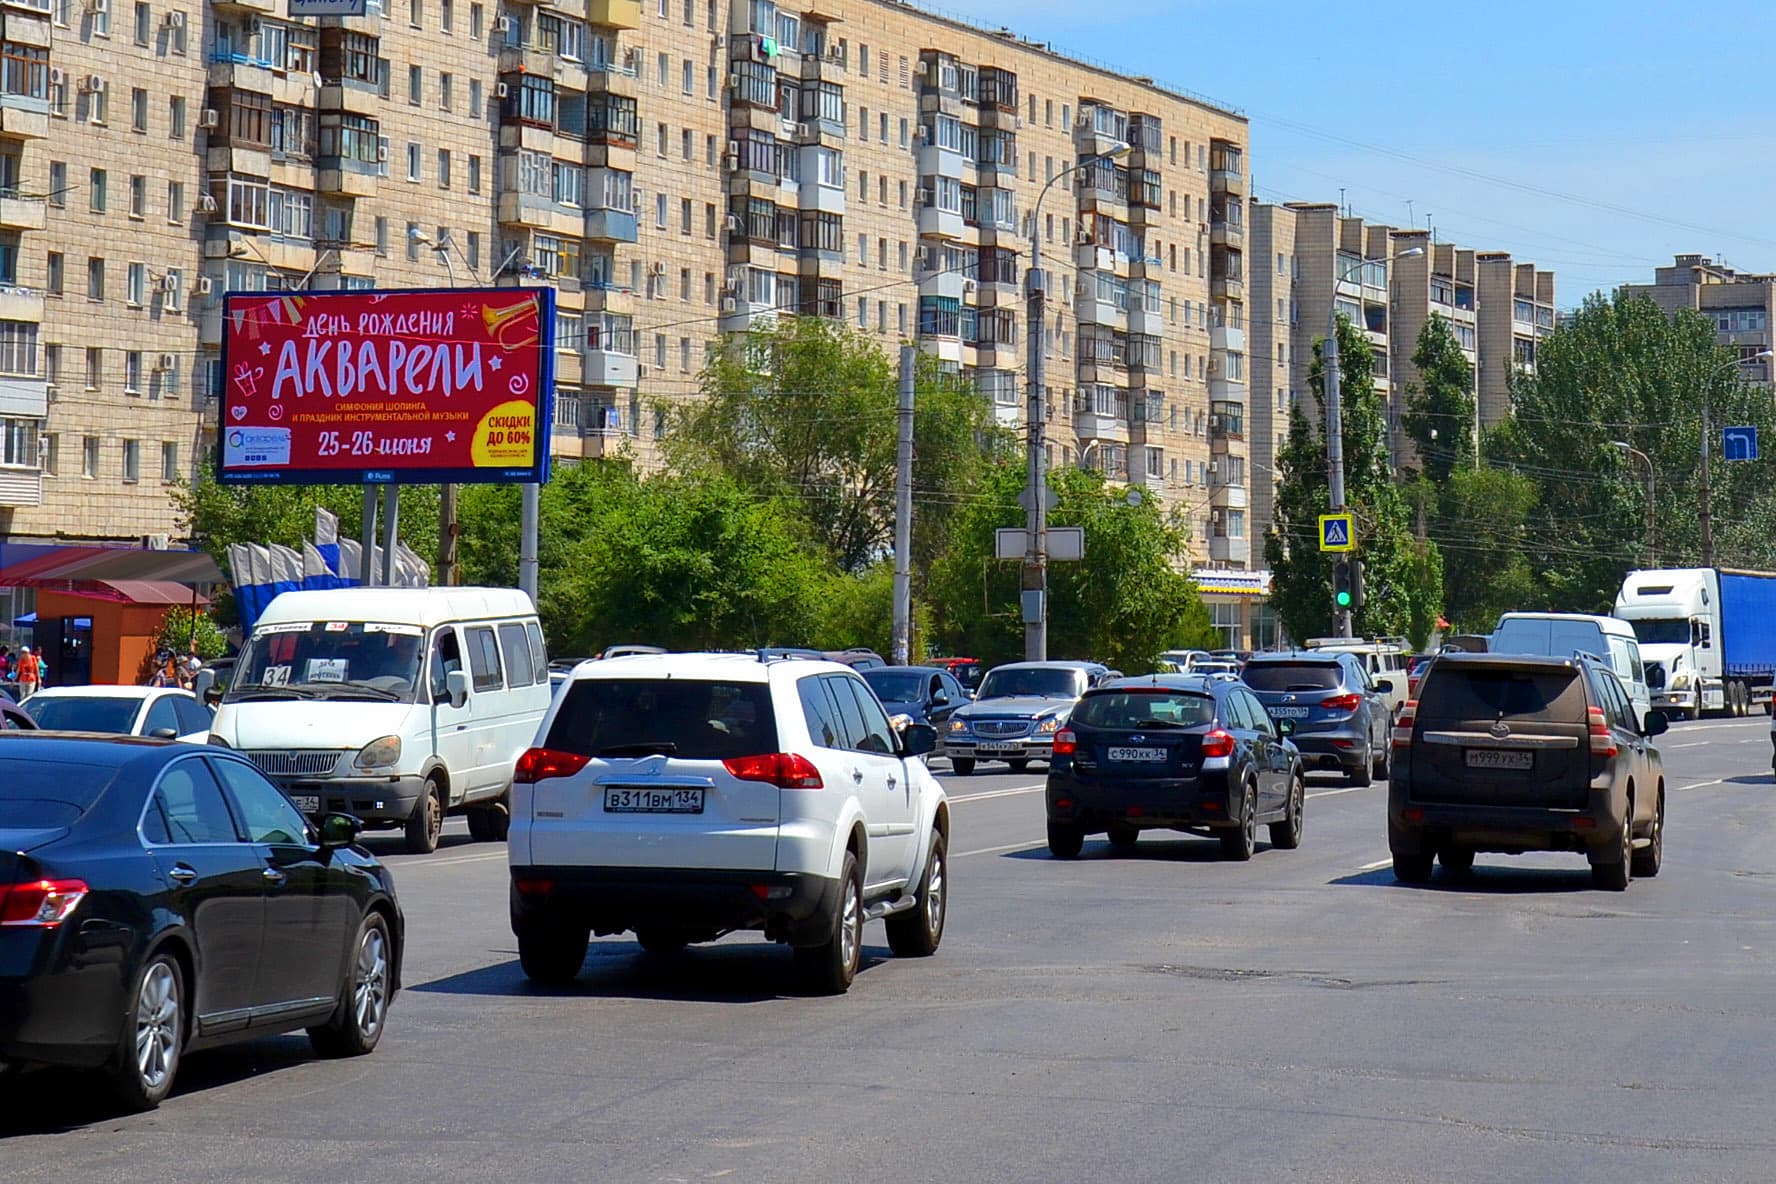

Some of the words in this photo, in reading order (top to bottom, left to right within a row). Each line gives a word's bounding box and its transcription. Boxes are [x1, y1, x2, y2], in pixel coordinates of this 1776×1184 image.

[335, 402, 384, 412] СИМФОНИЯ
[385, 401, 427, 411] ШОПИНГА
[292, 413, 299, 423] И
[300, 412, 343, 423] ПРАЗДНИК
[344, 410, 431, 422] ИНСТРУМЕНТАЛЬНОЙ
[432, 411, 469, 421] МУЗЫКИ
[488, 415, 531, 430] СКИДКИ
[486, 431, 504, 447] ДО
[507, 430, 531, 445] 60%
[264, 667, 292, 687] 34
[610, 790, 672, 807] В311ВМ
[675, 790, 699, 804] 134
